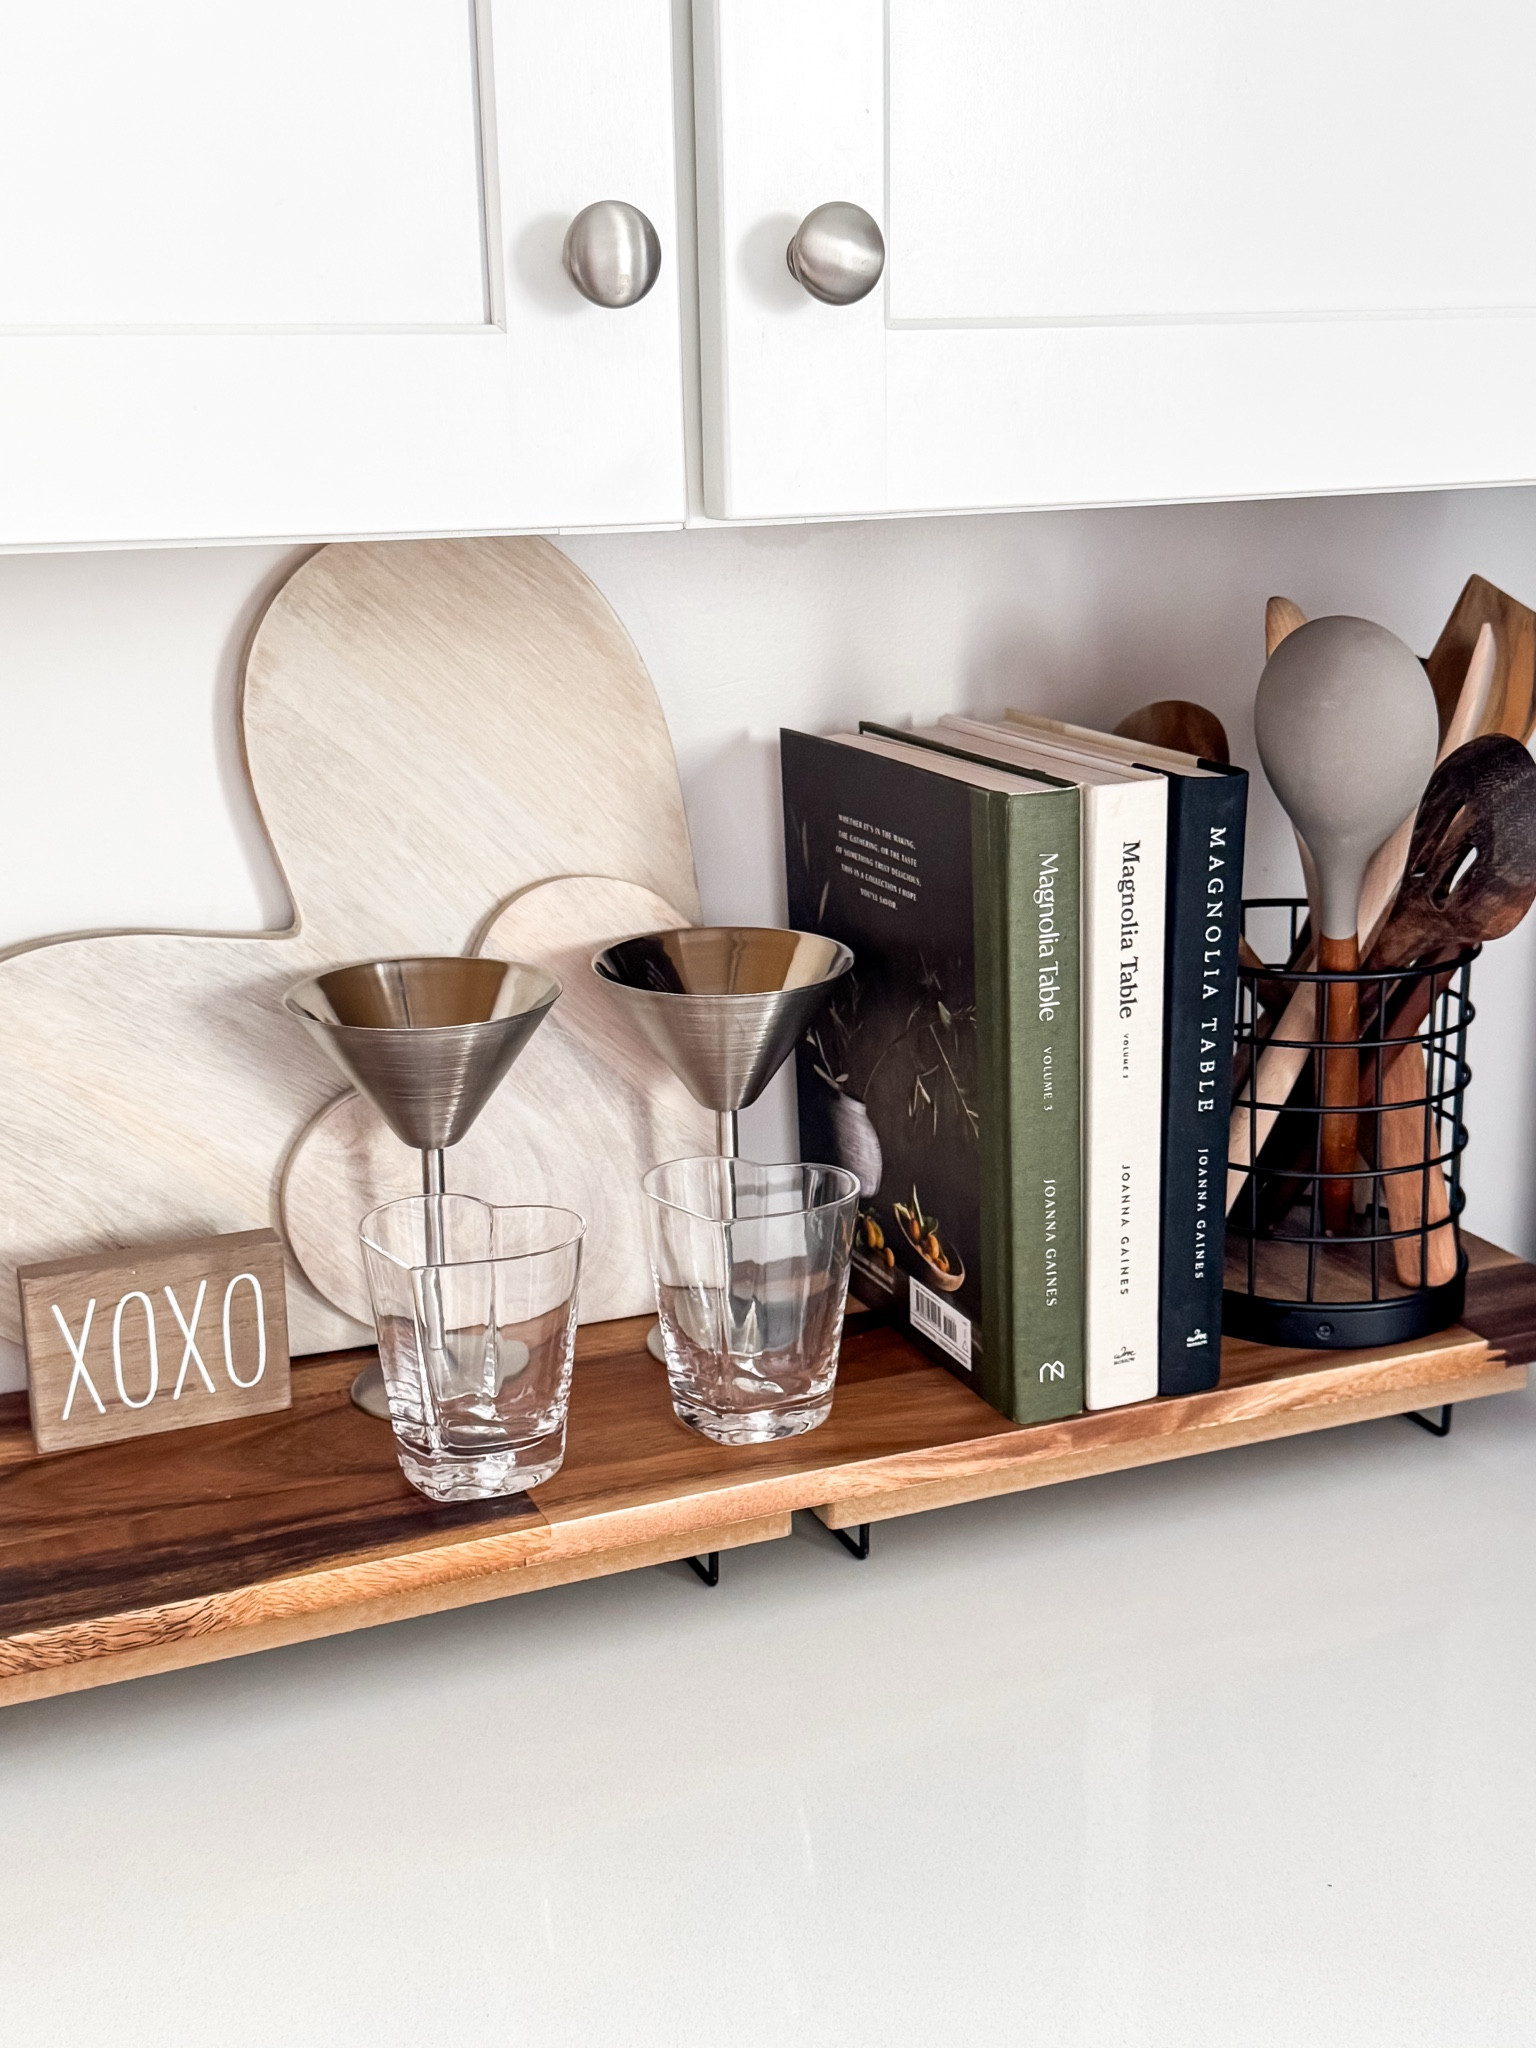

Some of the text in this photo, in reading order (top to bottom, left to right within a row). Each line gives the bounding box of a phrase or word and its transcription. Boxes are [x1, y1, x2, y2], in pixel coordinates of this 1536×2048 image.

[838, 813, 863, 829] WHETHER
[882, 829, 892, 841] THE
[892, 834, 916, 851] MAKING,
[890, 849, 900, 861] THE
[901, 855, 917, 868] TASTE
[1117, 839, 1142, 951] Magnolia
[1032, 853, 1061, 1112] Magnolia Table VOLUME 3
[1119, 955, 1140, 1020] Table
[1197, 827, 1227, 1113] MAGNOLIA TABLE
[1122, 1033, 1130, 1071] VOLUME
[1043, 1179, 1058, 1307] JOANNA GAINES
[1120, 1164, 1131, 1295] JOANNA GAINES
[1194, 1148, 1209, 1279] JOANNA GAINES
[51, 1273, 267, 1421] XOXO
